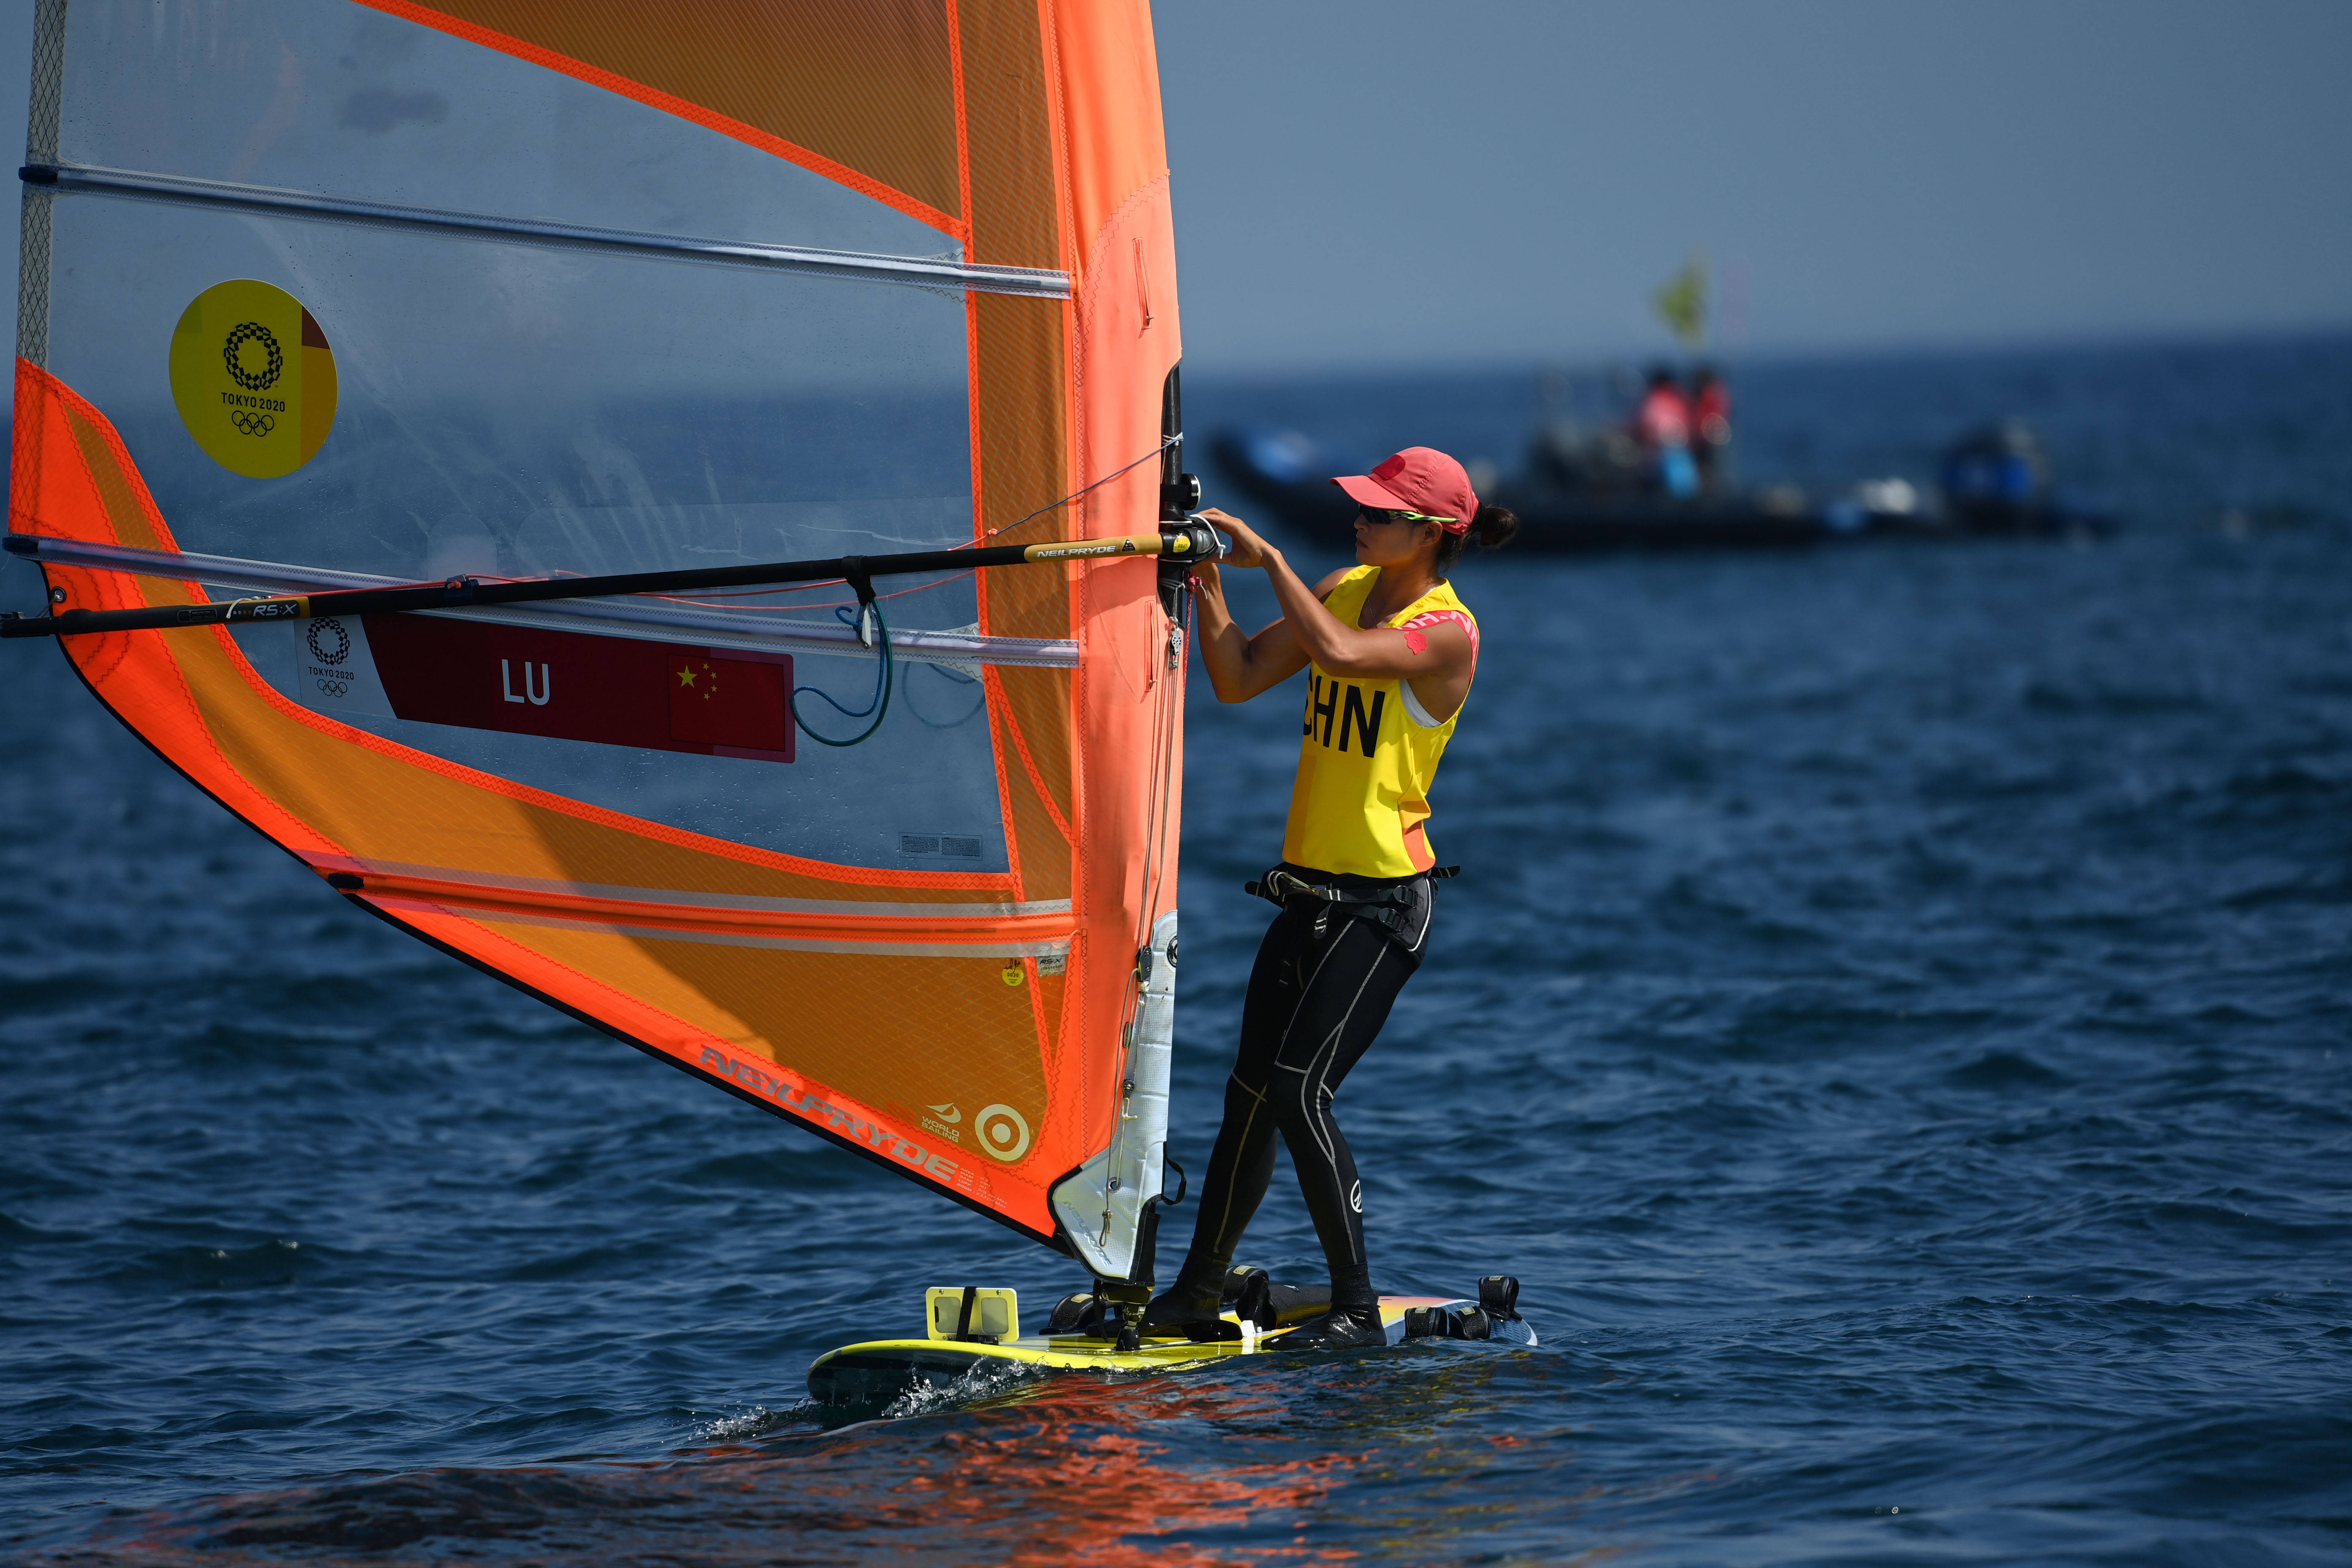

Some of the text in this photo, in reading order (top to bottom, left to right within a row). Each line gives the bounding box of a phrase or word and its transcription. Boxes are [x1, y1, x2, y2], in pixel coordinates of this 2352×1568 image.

[221, 392, 285, 412] TOKYO 2020
[1037, 546, 1116, 557] NEILPRYDE
[253, 604, 297, 616] RS:X
[308, 667, 354, 680] TOKYO 2020
[501, 659, 550, 705] LU
[698, 1046, 959, 1181] NEILPRYDE
[922, 1116, 960, 1137] WORLD
[922, 1122, 959, 1143] SAILING
